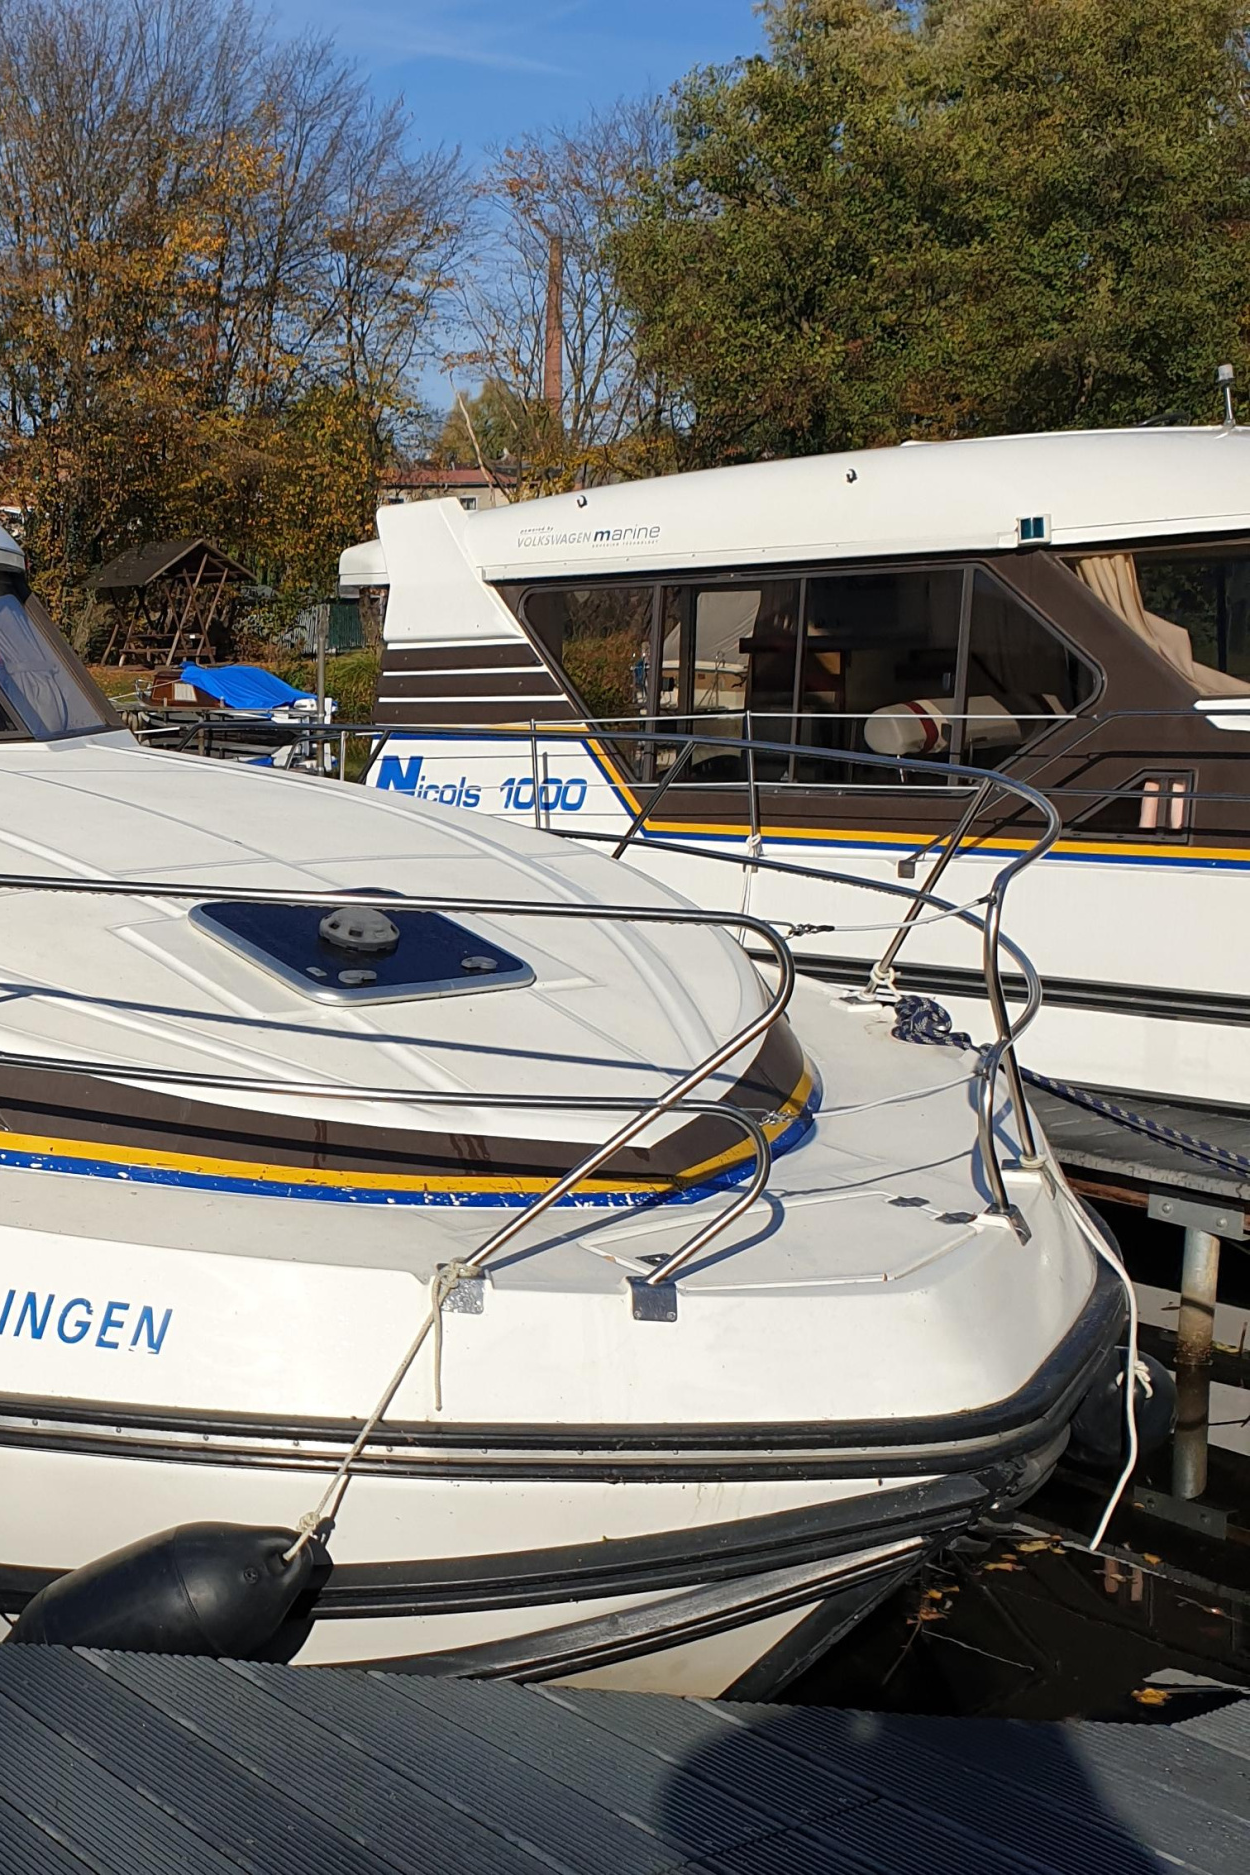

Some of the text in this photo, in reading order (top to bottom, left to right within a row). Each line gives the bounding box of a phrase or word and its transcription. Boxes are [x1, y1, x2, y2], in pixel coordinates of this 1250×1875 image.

[517, 531, 592, 548] VOLKSWAGEN
[593, 524, 661, 542] marine
[375, 755, 588, 811] Nicols 1000
